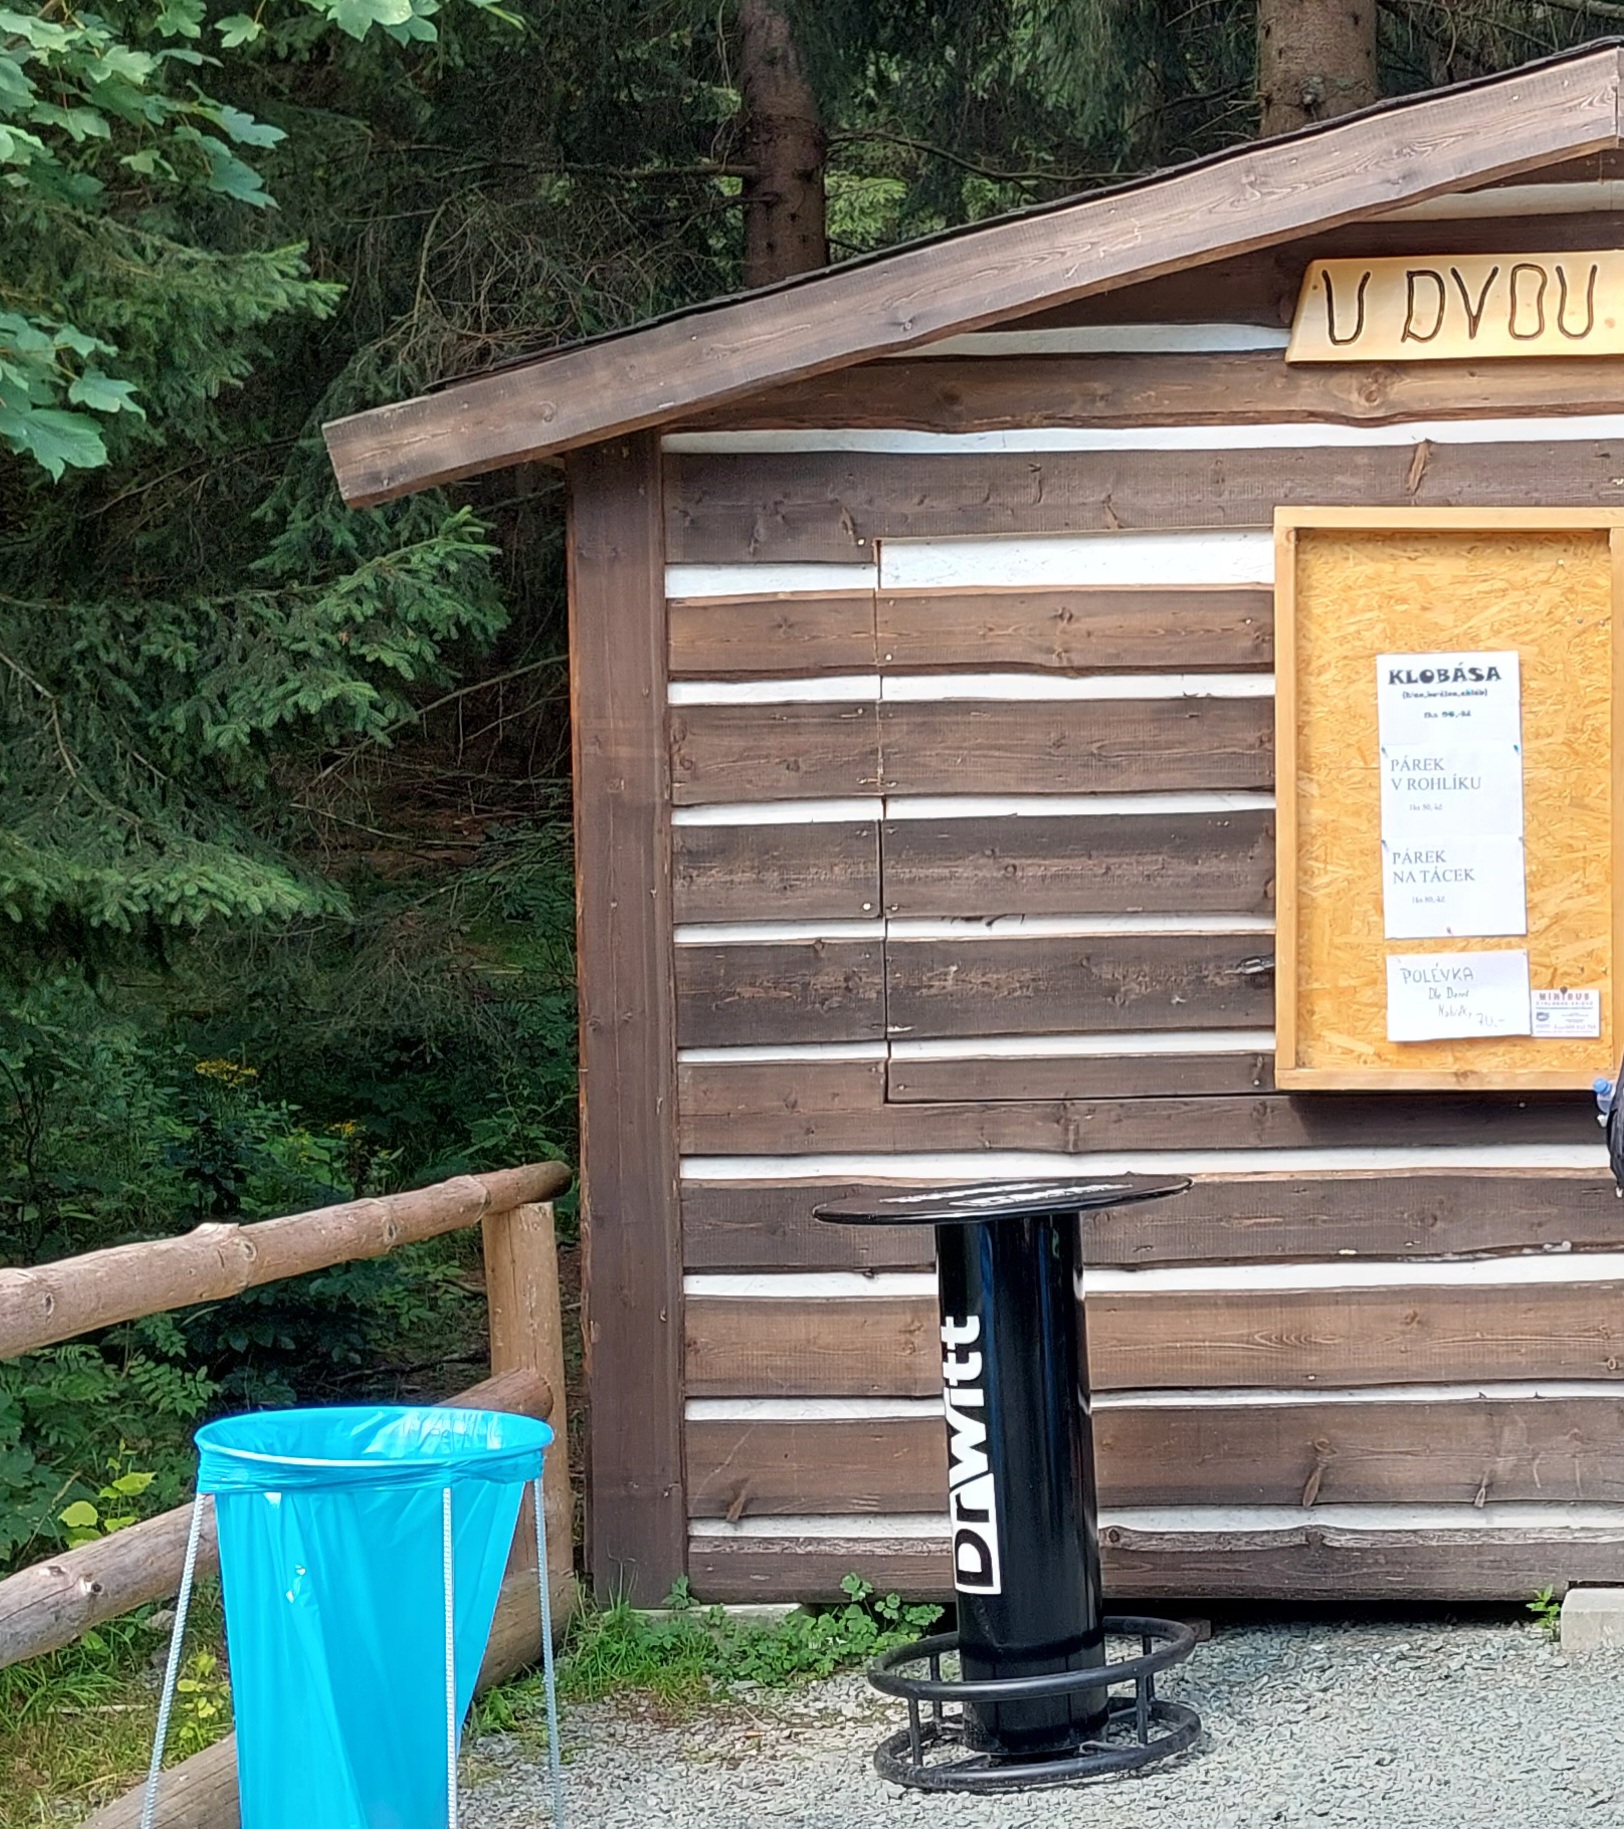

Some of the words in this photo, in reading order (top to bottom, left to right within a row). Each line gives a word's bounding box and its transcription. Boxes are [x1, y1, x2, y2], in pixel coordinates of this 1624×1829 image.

[1322, 268, 1370, 345] U
[1401, 262, 1597, 344] DVOU
[1388, 662, 1502, 685] KLOBÁSA
[1390, 757, 1445, 772] PÁREK
[1391, 778, 1402, 791] V
[1407, 773, 1482, 791] ROHLÍKU
[1392, 849, 1447, 865] PÁREK
[1393, 870, 1416, 884] NA
[1420, 866, 1476, 883] TÁCEK
[1400, 963, 1474, 984] POLÉVKA
